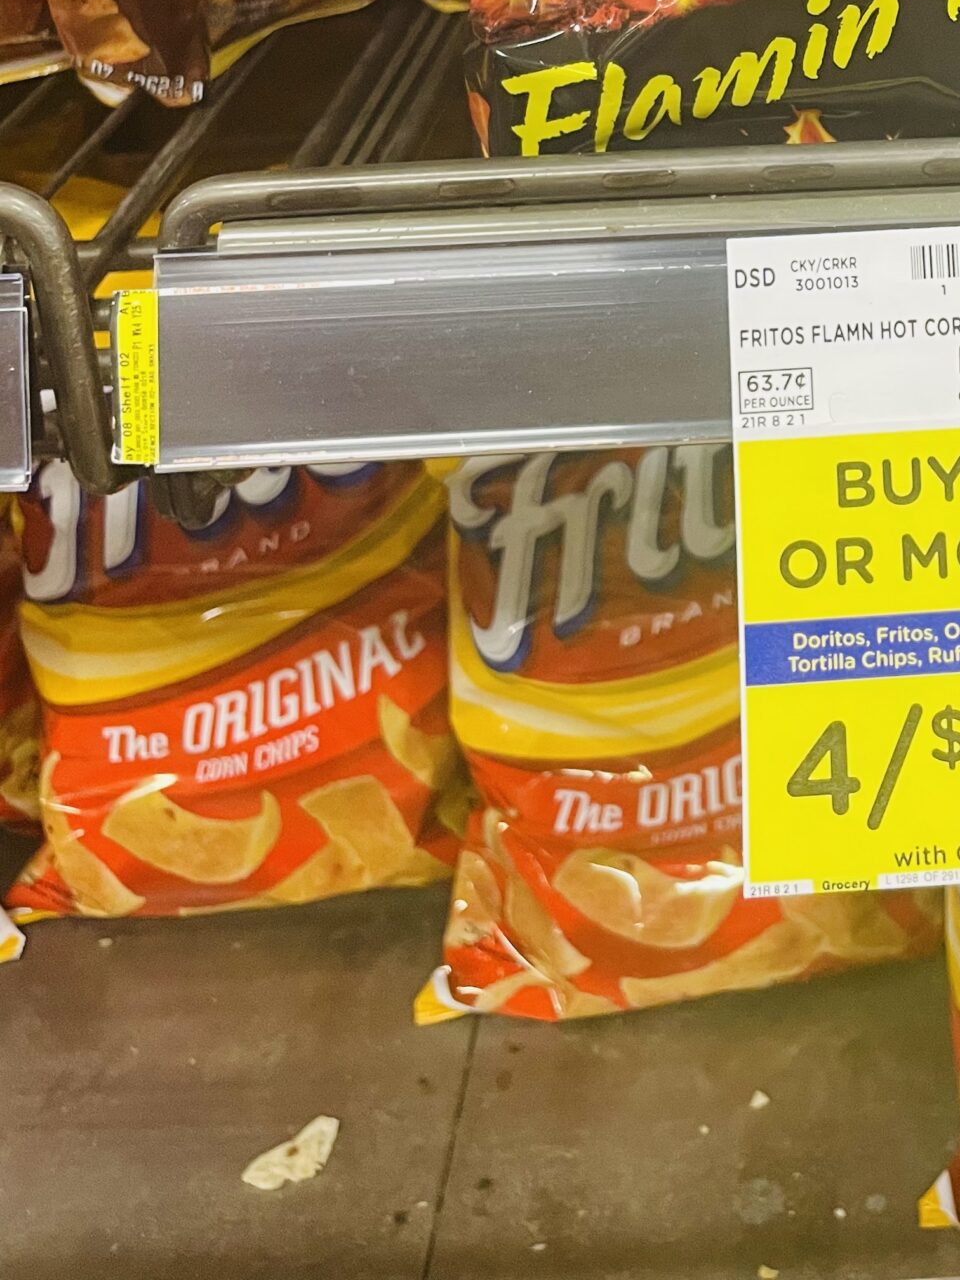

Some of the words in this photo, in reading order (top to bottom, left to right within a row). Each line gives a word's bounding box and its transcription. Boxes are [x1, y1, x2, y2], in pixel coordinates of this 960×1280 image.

[734, 268, 776, 289] DSD
[790, 257, 858, 274] CKY/CRKR
[795, 275, 859, 292] 3001013
[940, 284, 947, 296] 1
[739, 327, 805, 348] FRITOS
[811, 322, 874, 345] FLAMN
[880, 319, 917, 340] HOT
[746, 372, 808, 393] 63.7¢
[121, 377, 132, 415] Shelf
[743, 397, 768, 410] PER
[769, 394, 811, 408] OUNCE
[741, 414, 768, 429] 21R
[772, 414, 781, 427] 8
[786, 414, 795, 427] 2
[779, 536, 875, 590] OR
[792, 627, 871, 651] Doritos,
[876, 624, 940, 645] Fritos,
[787, 652, 857, 674] Tortilla
[862, 650, 923, 671] Chips,
[102, 723, 170, 763] The
[196, 750, 249, 782] CORN
[254, 725, 320, 772] CHIPS
[553, 787, 623, 833] The
[893, 846, 947, 868] with
[821, 879, 871, 893] Grocery
[923, 872, 940, 883] OF
